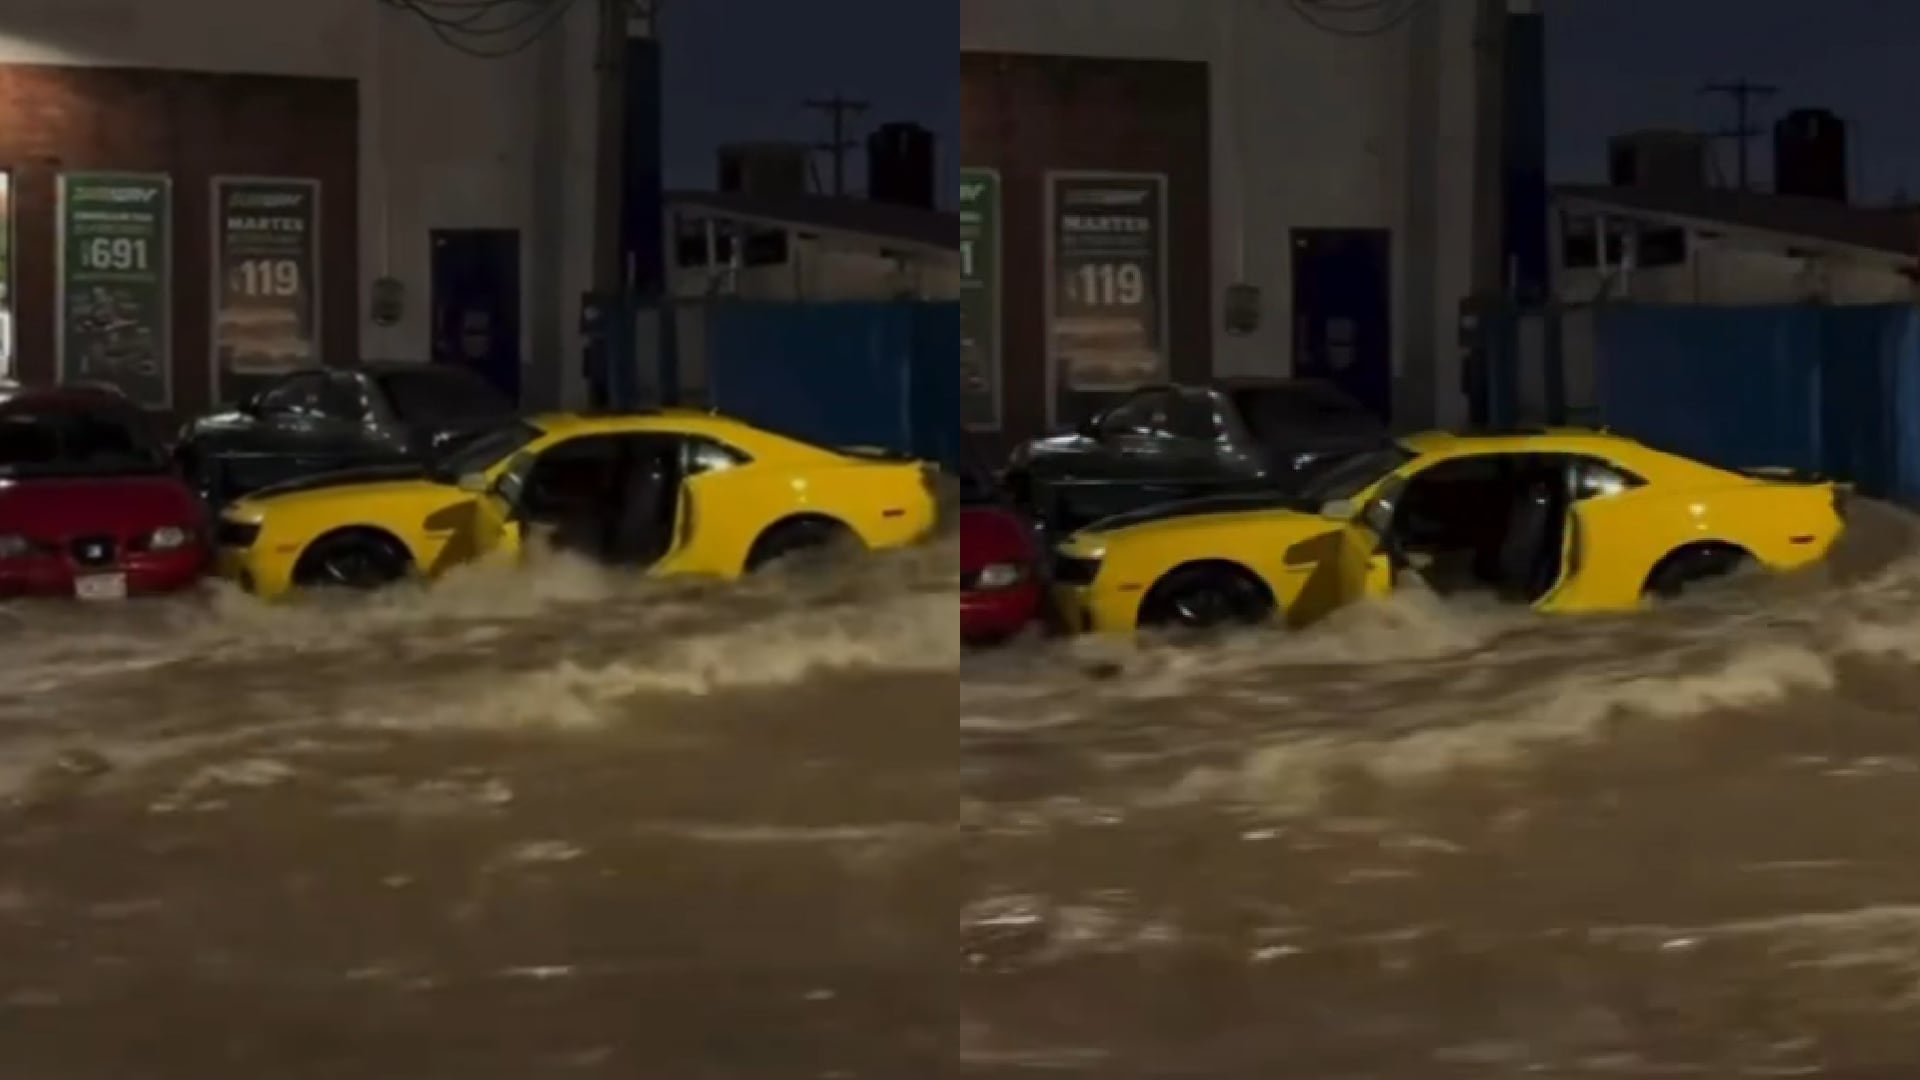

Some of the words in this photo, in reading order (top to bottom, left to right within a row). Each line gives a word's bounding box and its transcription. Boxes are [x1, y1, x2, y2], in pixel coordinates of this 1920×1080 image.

[91, 238, 147, 269] 691
[240, 259, 299, 296] 119
[1081, 262, 1142, 305] 119
